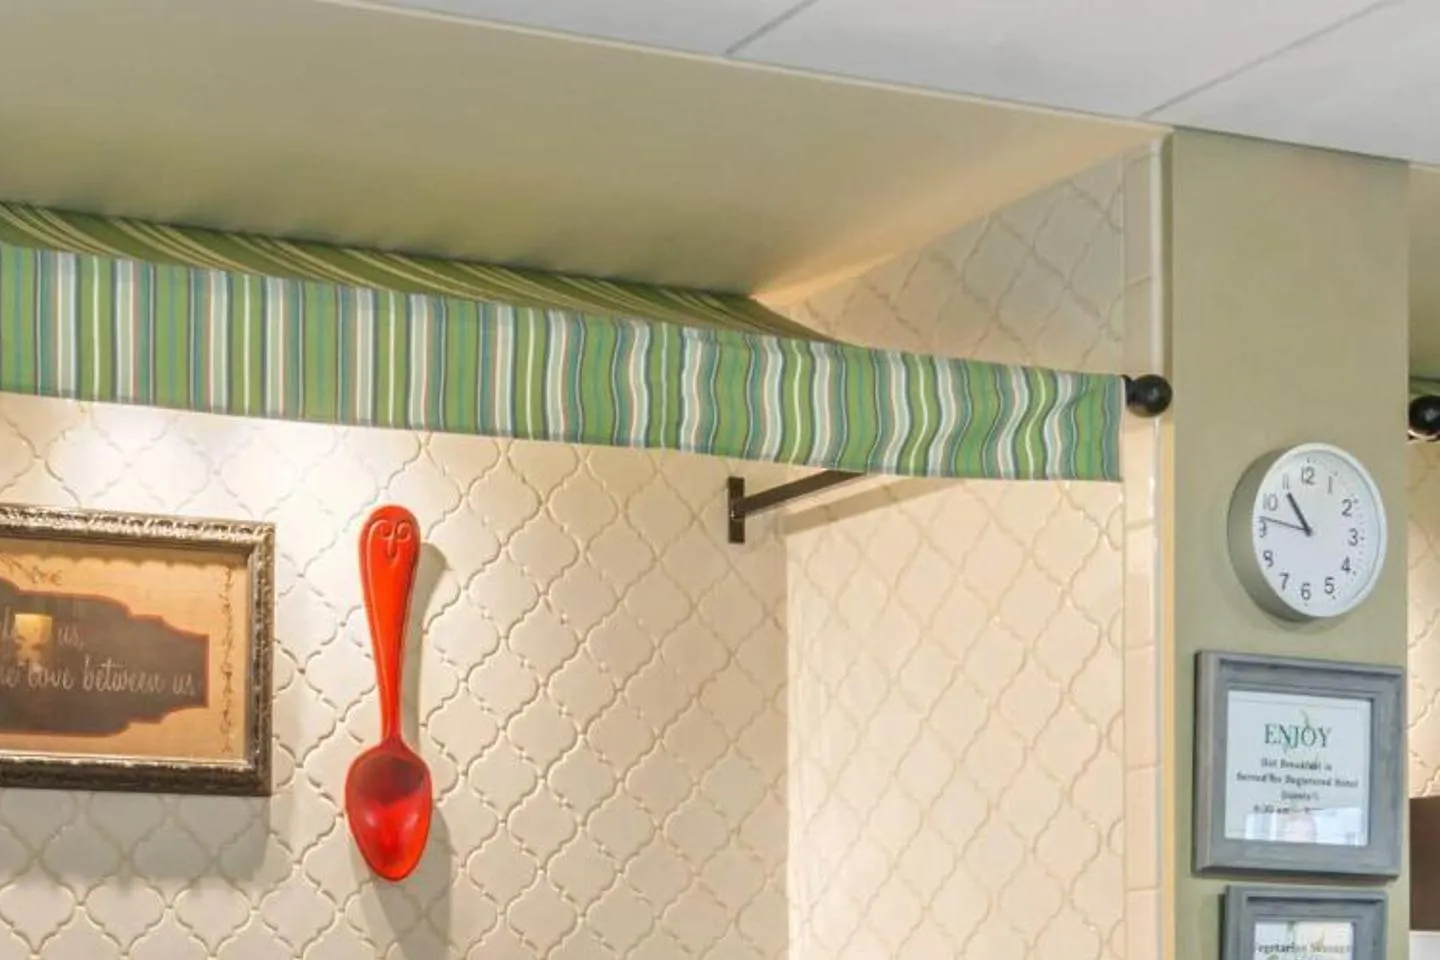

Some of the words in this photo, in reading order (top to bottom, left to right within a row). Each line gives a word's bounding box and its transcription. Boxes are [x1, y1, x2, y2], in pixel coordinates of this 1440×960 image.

[1282, 473, 1290, 489] 11
[1301, 466, 1315, 485] 12
[1327, 475, 1333, 494] 1
[1263, 493, 1278, 511] 10
[1341, 499, 1353, 517] 2
[1259, 519, 1267, 538] 9
[1348, 528, 1359, 546] 3
[1263, 550, 1274, 568] 8
[1341, 557, 1351, 574] 4
[1280, 573, 1289, 590] 7
[1324, 577, 1335, 594] 5
[1301, 583, 1311, 600] 6
[82, 653, 166, 692] between
[1264, 722, 1332, 749] ENJOY
[1280, 758, 1321, 771] Breakfast
